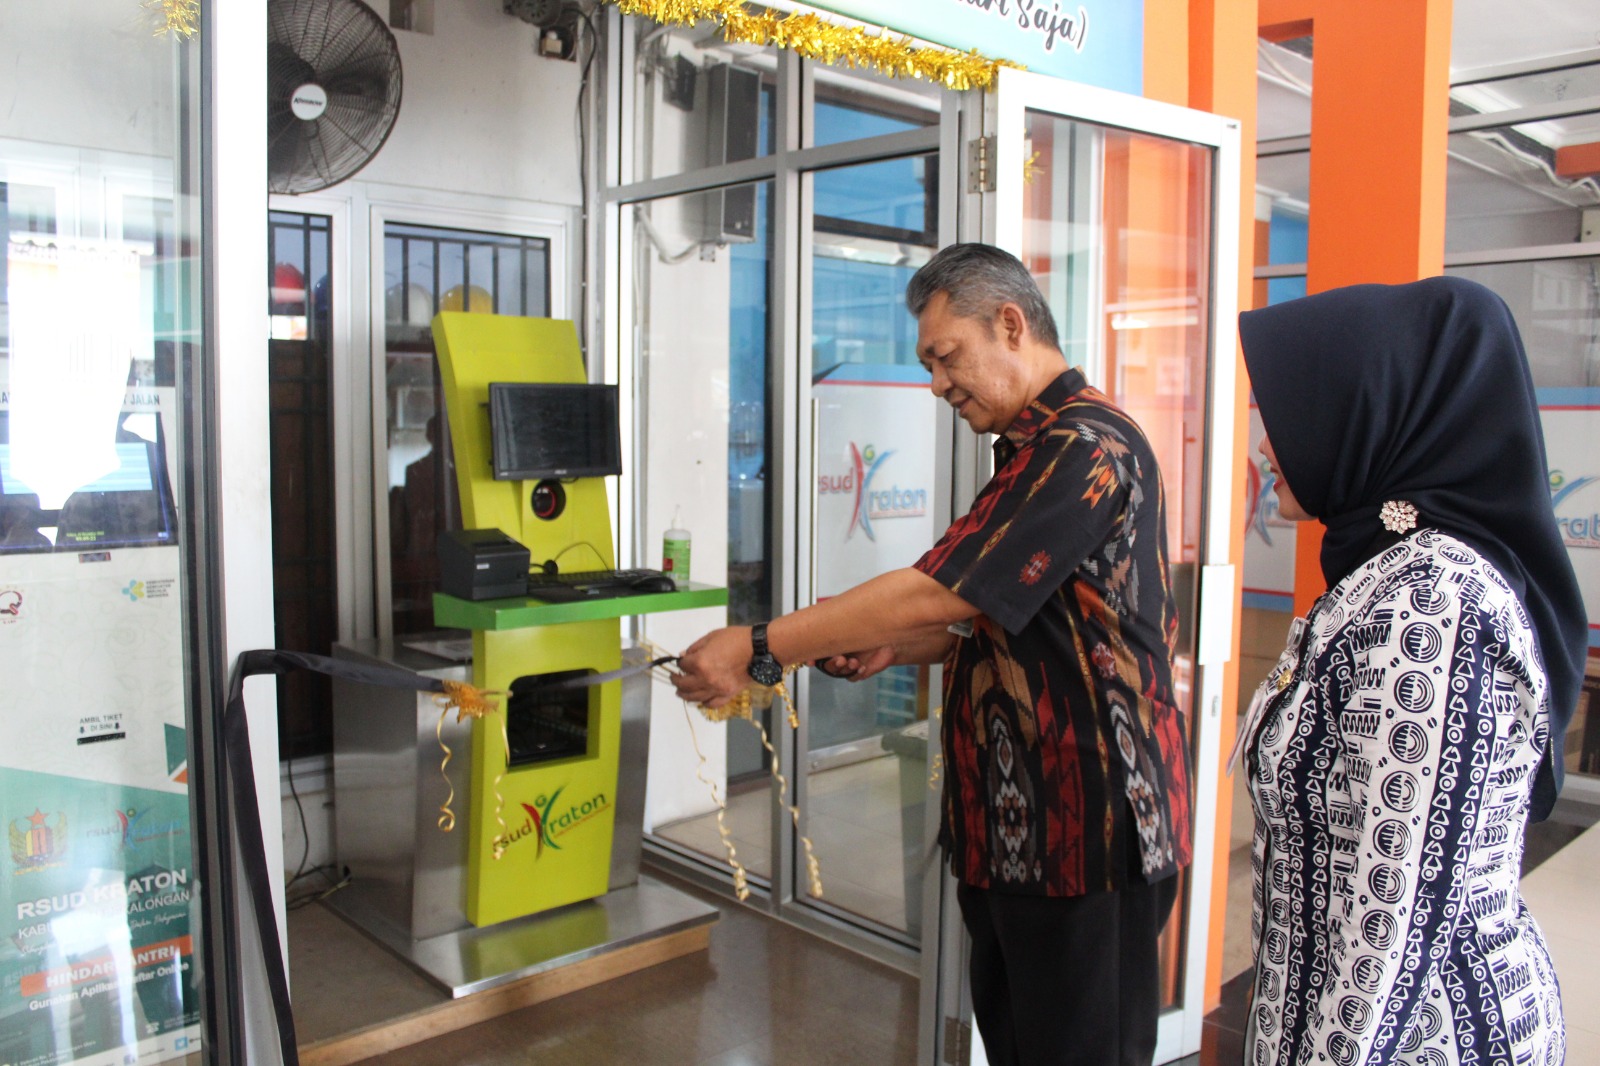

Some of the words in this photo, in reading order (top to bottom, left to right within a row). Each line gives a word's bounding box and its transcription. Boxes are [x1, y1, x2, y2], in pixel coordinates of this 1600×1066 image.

[1017, 0, 1086, 51] Saja)
[79, 716, 101, 724] AMBIL
[103, 713, 123, 722] TIKET
[90, 724, 98, 732] DI
[17, 889, 87, 920] RSUD
[46, 961, 117, 988] HINDAR
